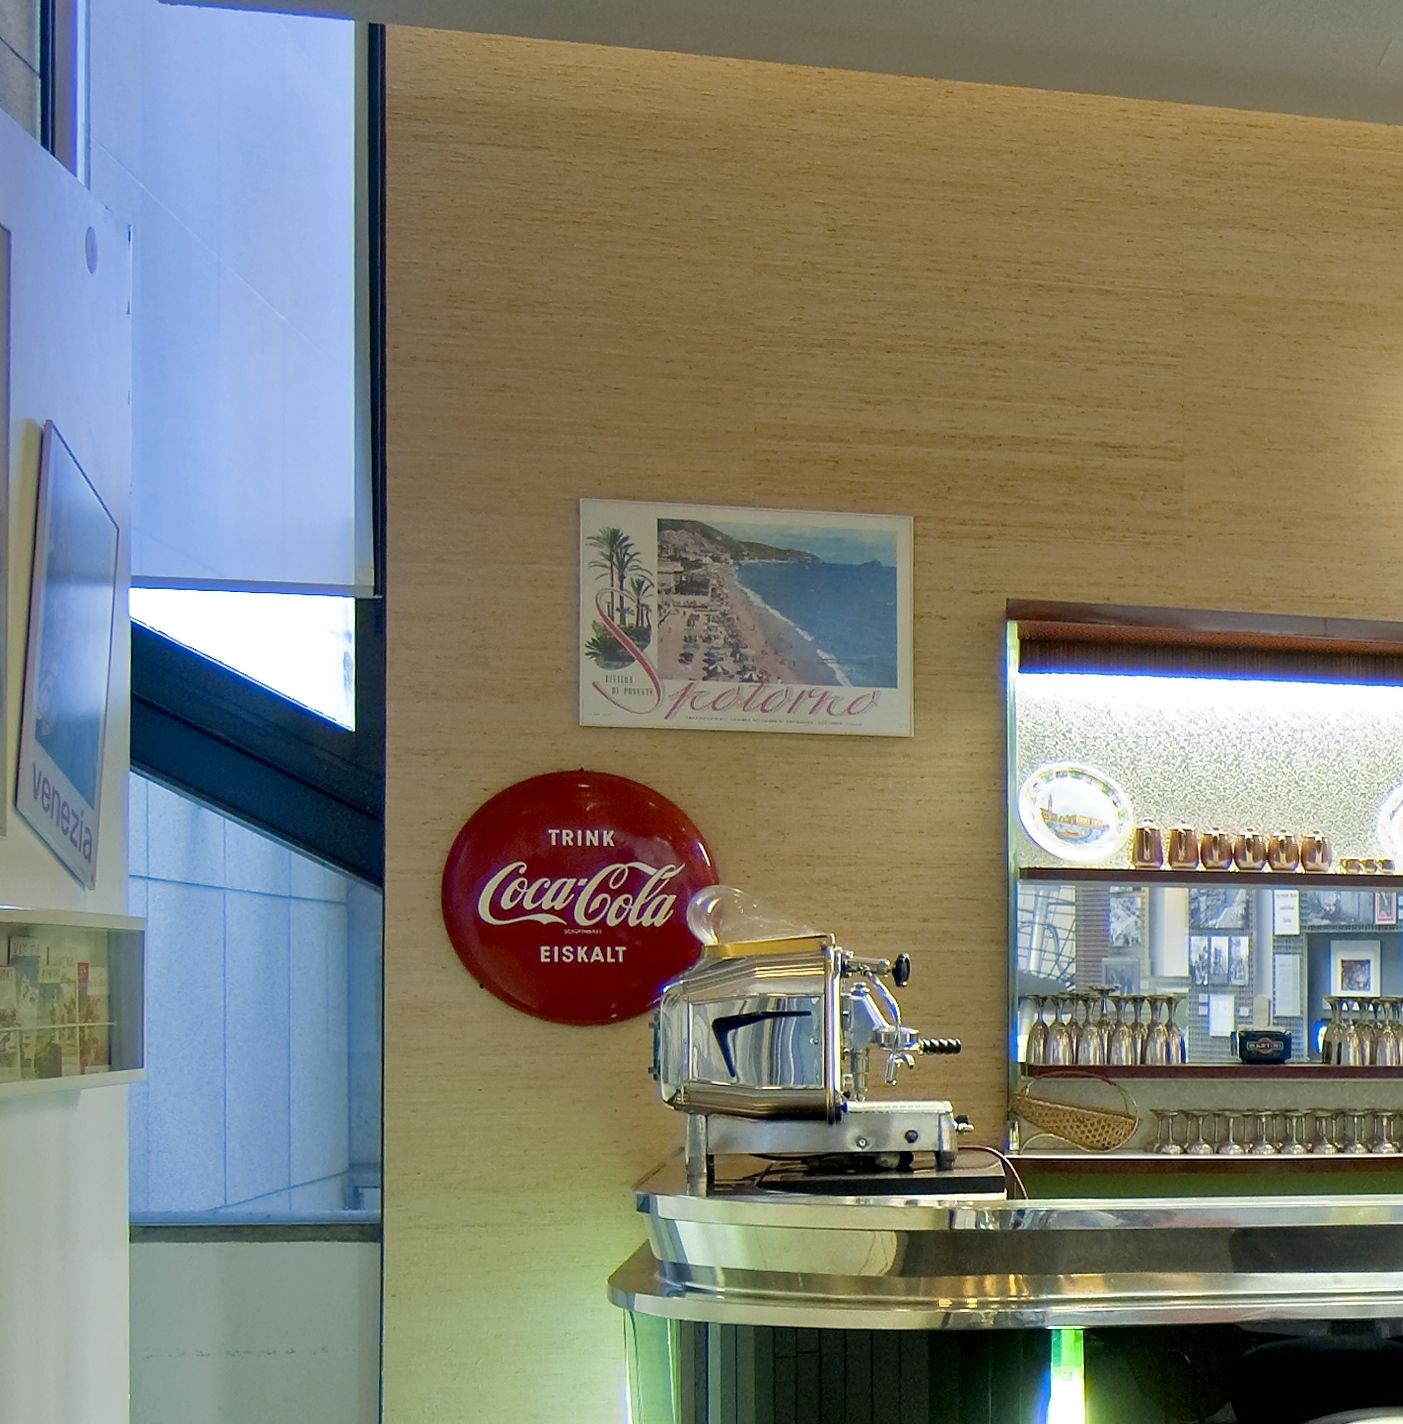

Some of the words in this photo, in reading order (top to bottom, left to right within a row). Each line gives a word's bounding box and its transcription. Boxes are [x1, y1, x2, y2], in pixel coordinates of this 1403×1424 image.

[32, 762, 92, 864] venezia
[548, 829, 615, 847] TRINK
[478, 860, 686, 928] Coca-Cola
[540, 946, 627, 963] EISKALT
